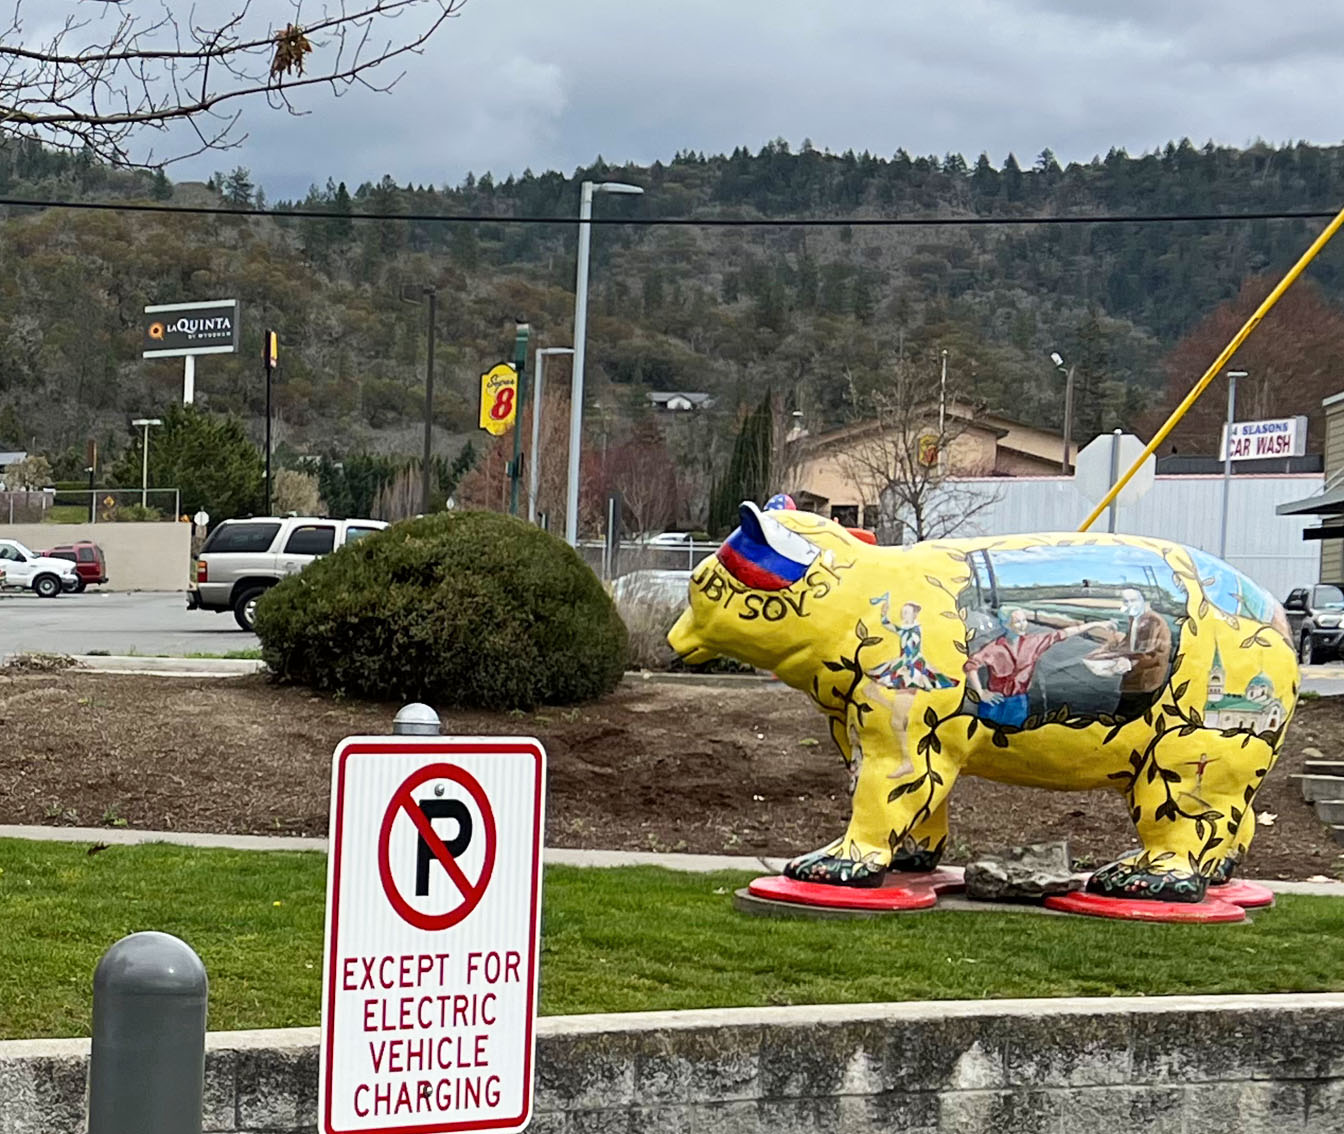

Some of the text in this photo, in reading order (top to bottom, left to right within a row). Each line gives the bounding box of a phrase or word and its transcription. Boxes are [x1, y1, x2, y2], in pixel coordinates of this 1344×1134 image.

[177, 318, 231, 333] QUINTA
[487, 374, 515, 392] Super
[490, 387, 515, 420] 8
[1243, 423, 1288, 435] SEASONS
[1256, 434, 1291, 455] WASH
[415, 798, 473, 896] P
[343, 950, 521, 990] EXCEPT FOR
[363, 993, 497, 1032] ELECTRIC
[369, 1034, 489, 1074] VEHICLE
[354, 1075, 501, 1118] CHARGING
